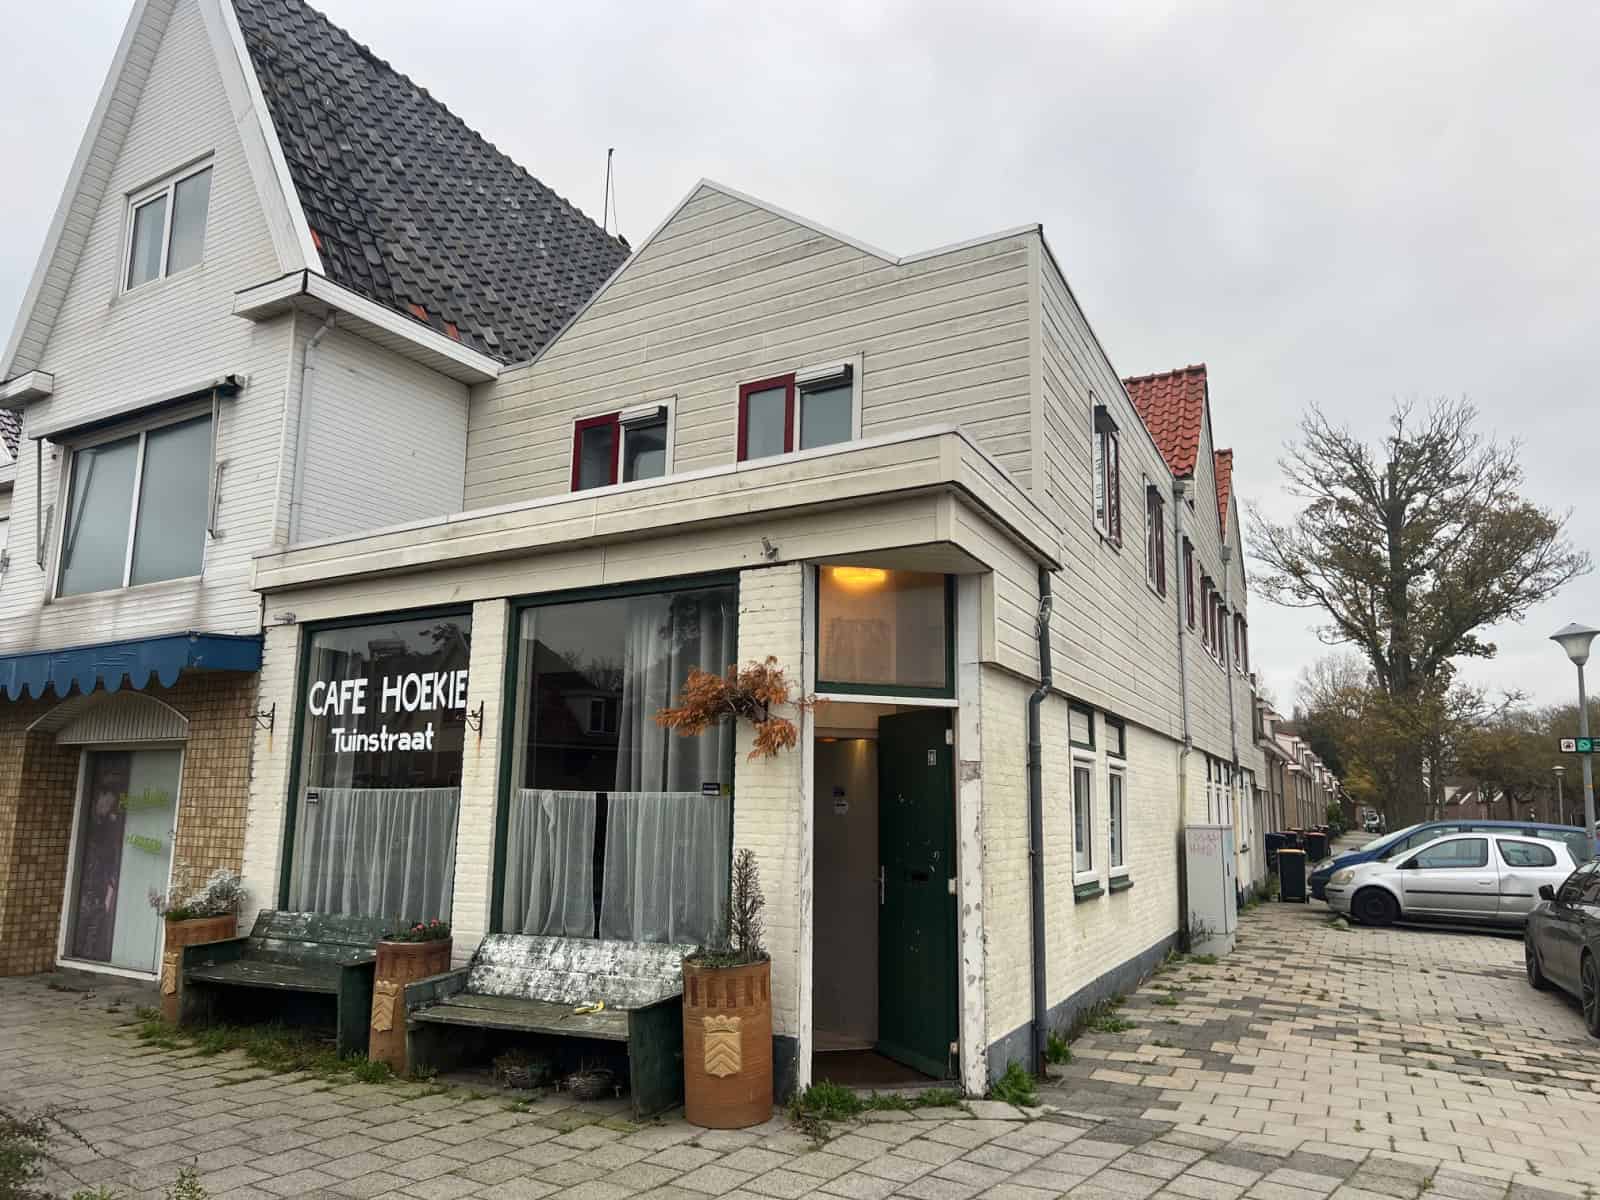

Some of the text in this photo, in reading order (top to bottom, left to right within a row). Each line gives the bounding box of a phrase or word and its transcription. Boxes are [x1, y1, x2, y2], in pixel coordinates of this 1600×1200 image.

[308, 670, 468, 716] CAFE HOEKIE
[332, 722, 434, 753] Tuinstraat
